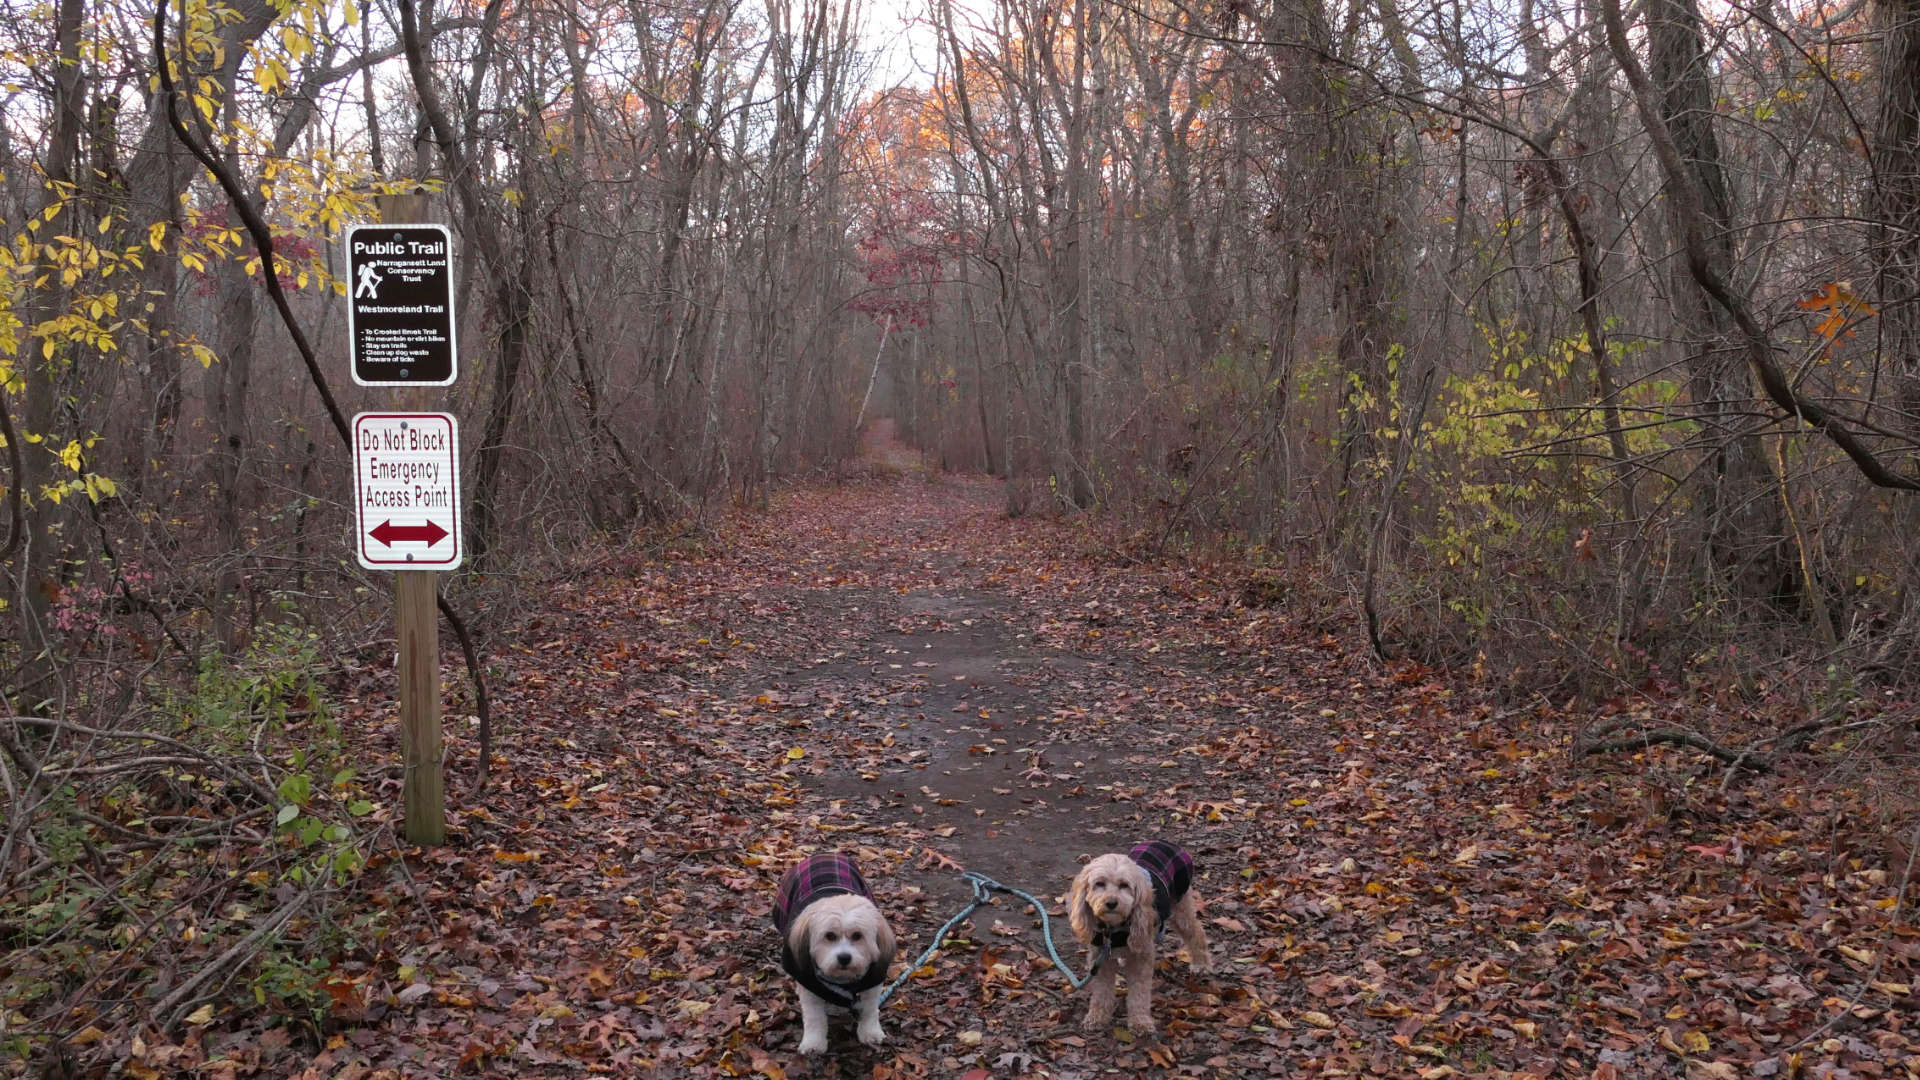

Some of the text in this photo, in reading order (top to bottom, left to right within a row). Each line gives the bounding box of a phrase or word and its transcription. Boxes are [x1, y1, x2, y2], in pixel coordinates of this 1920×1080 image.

[354, 242, 444, 254] Public Trail
[363, 428, 444, 450] Do Not Block
[370, 457, 439, 484] Emergency
[366, 485, 448, 507] Access Point
